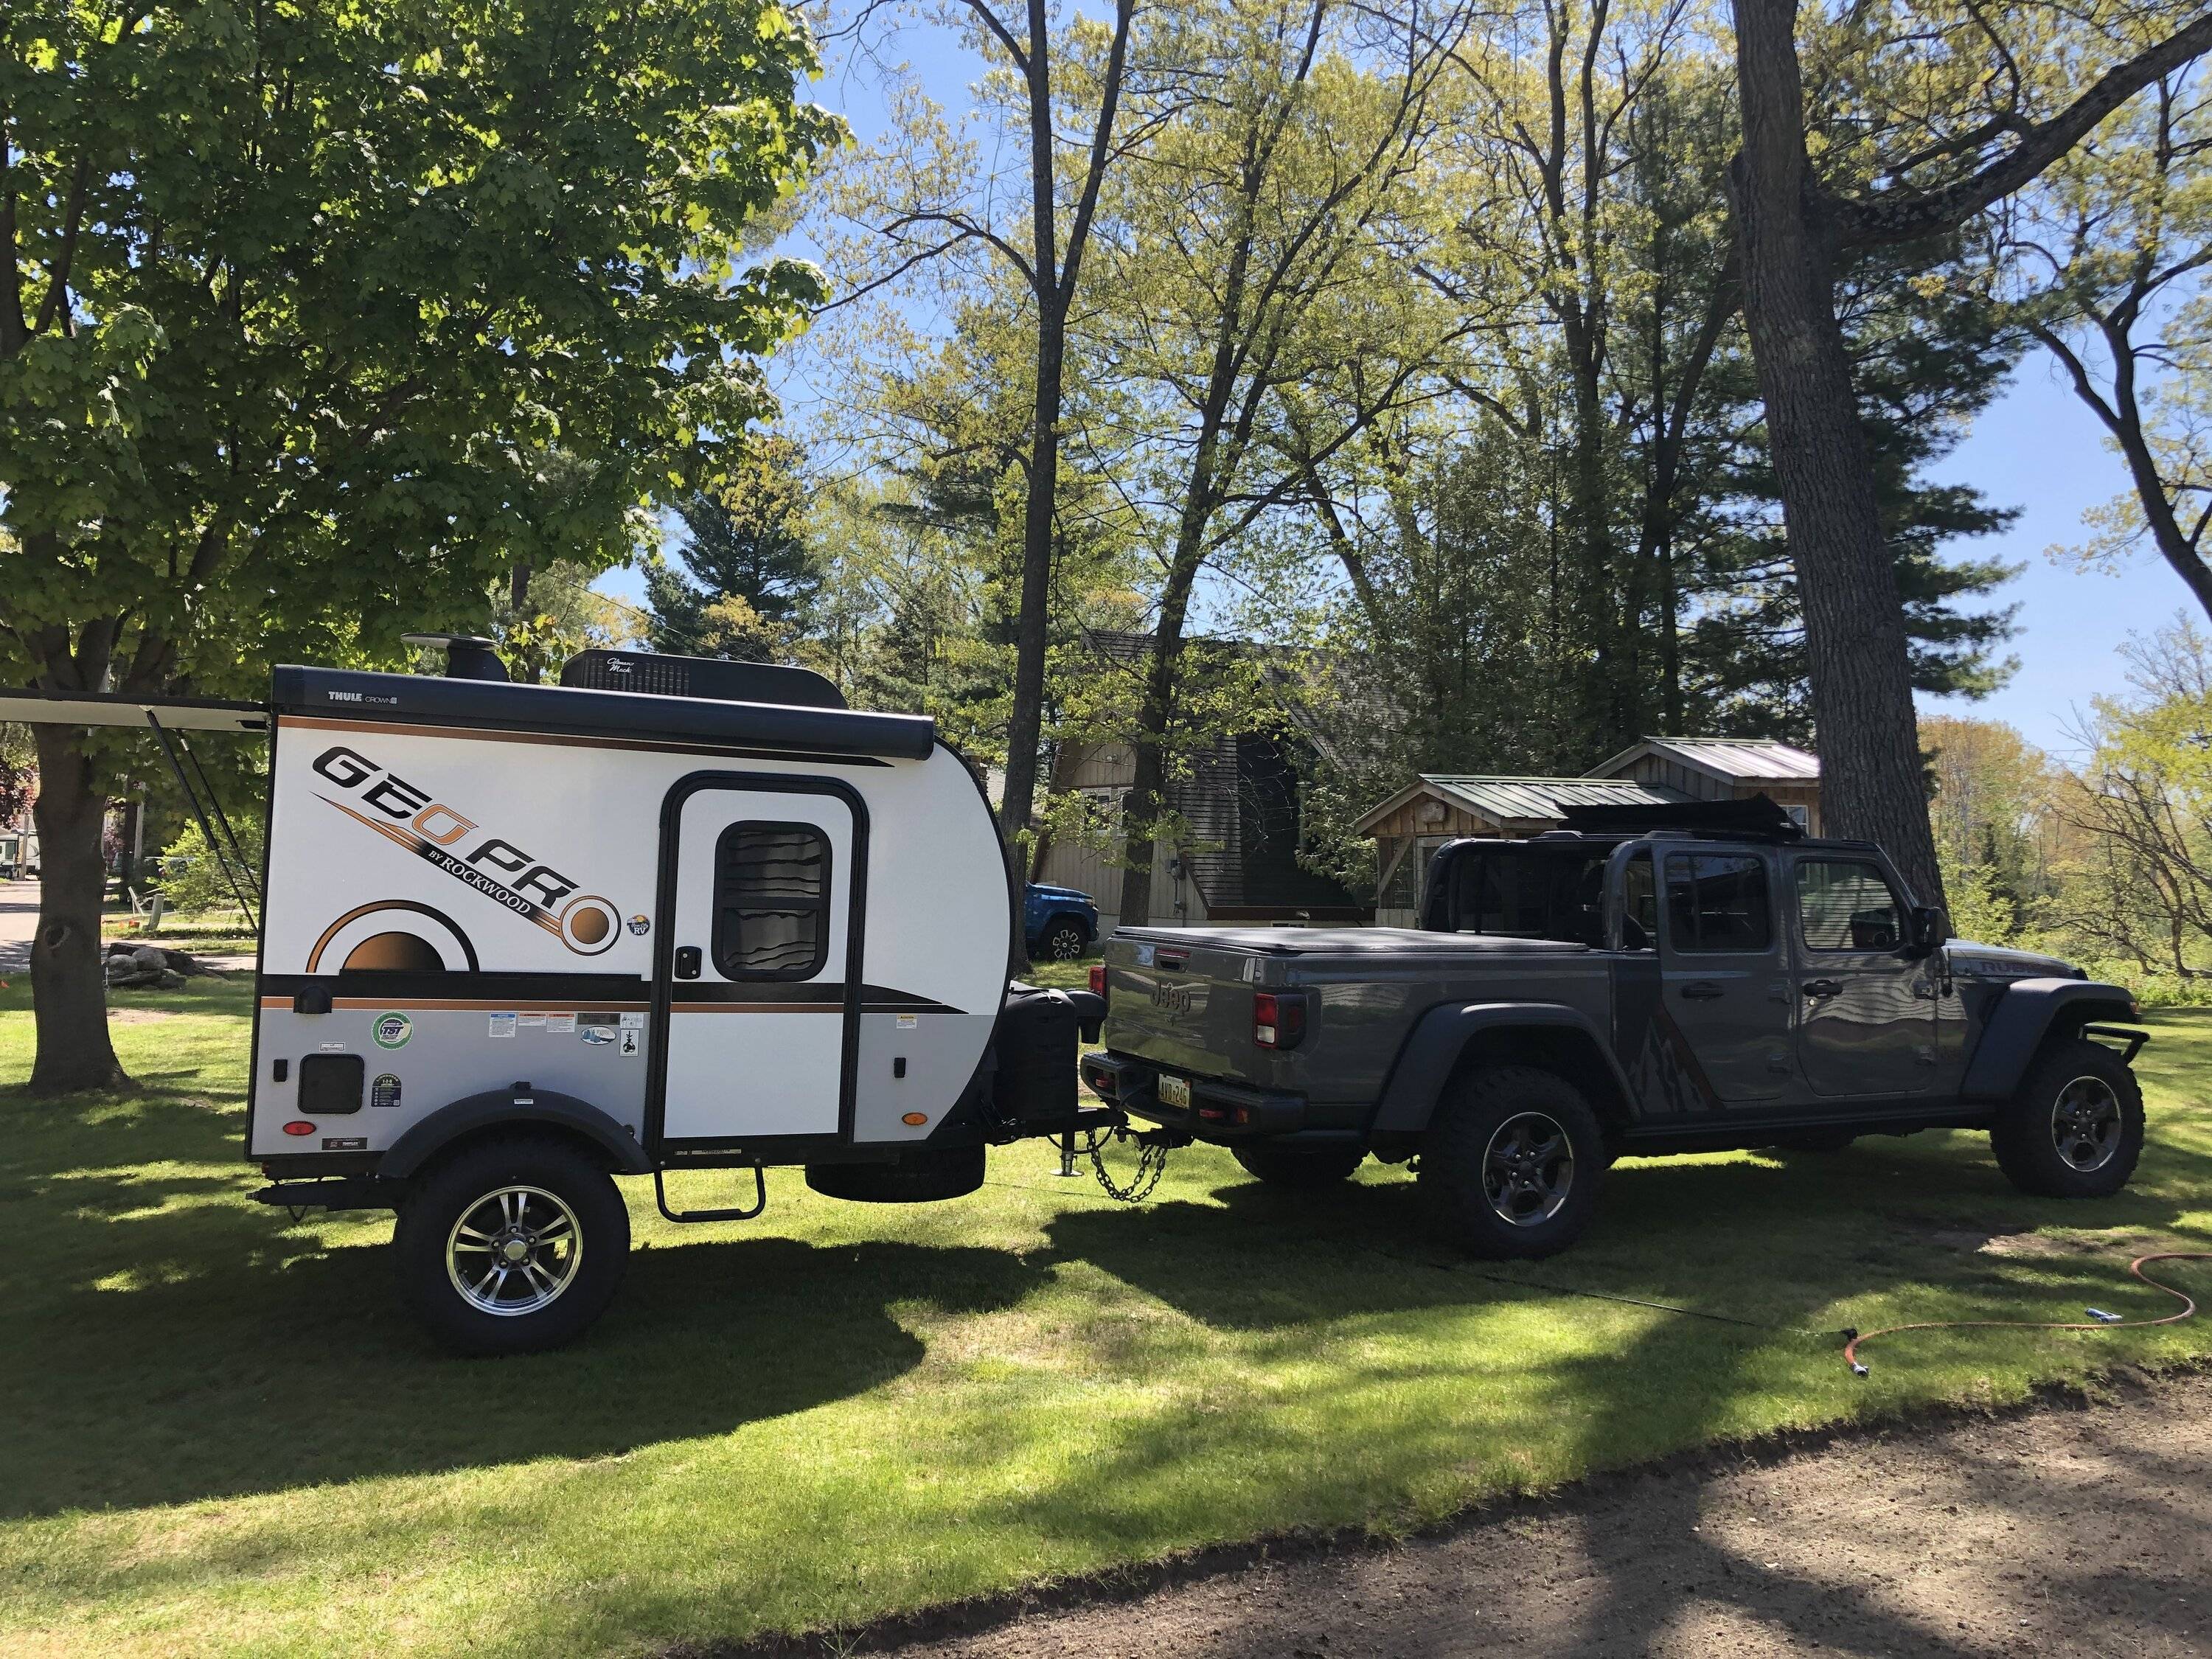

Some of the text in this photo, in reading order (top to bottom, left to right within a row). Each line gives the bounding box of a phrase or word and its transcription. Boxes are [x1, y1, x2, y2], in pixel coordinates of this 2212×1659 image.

[609, 664, 632, 672] Mach
[328, 691, 362, 702] THULE
[313, 746, 479, 846] GEO
[428, 849, 532, 914] BY ROCKWOOD
[1150, 980, 1192, 1016] Jeep
[382, 1026, 404, 1035] TST
